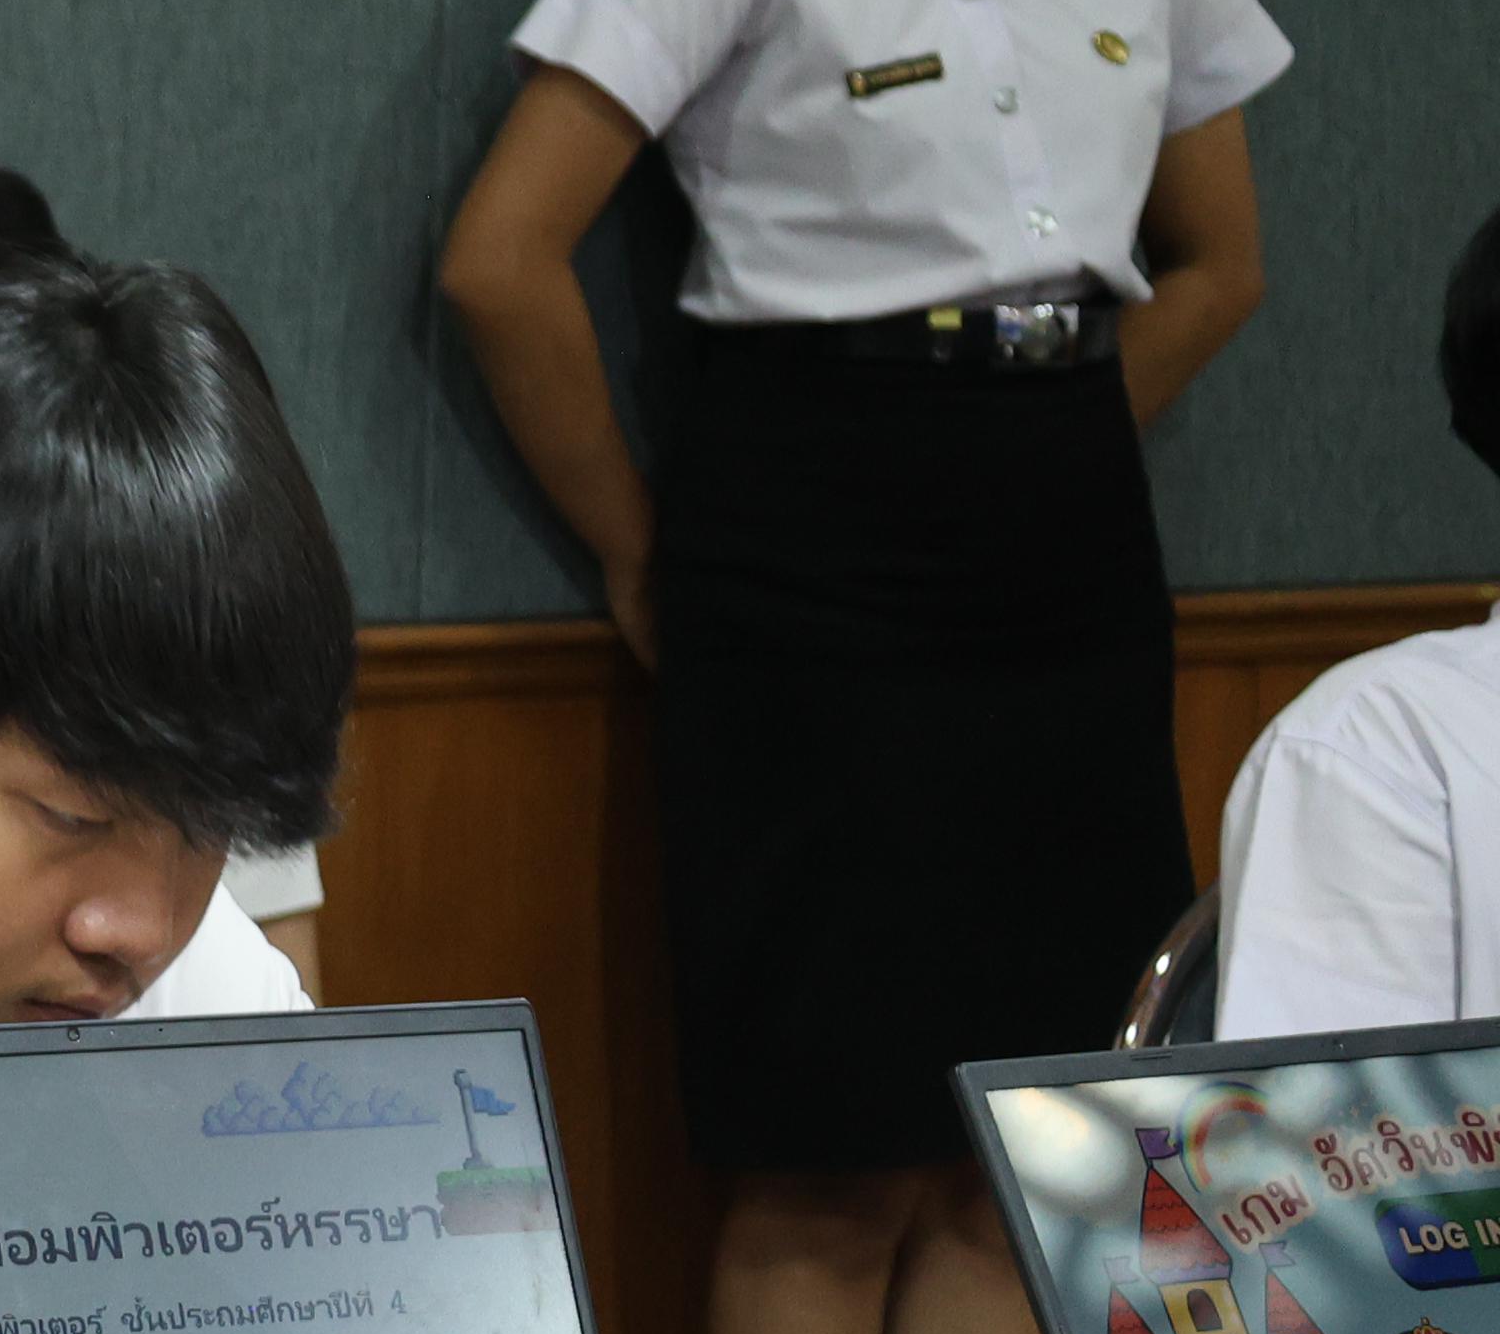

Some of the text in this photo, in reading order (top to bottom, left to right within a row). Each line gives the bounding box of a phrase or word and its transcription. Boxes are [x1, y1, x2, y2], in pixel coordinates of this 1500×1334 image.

[1221, 1111, 1500, 1245] เกม อัศวินพิ
[1398, 1220, 1469, 1255] LOG
[390, 1289, 408, 1315] 4
